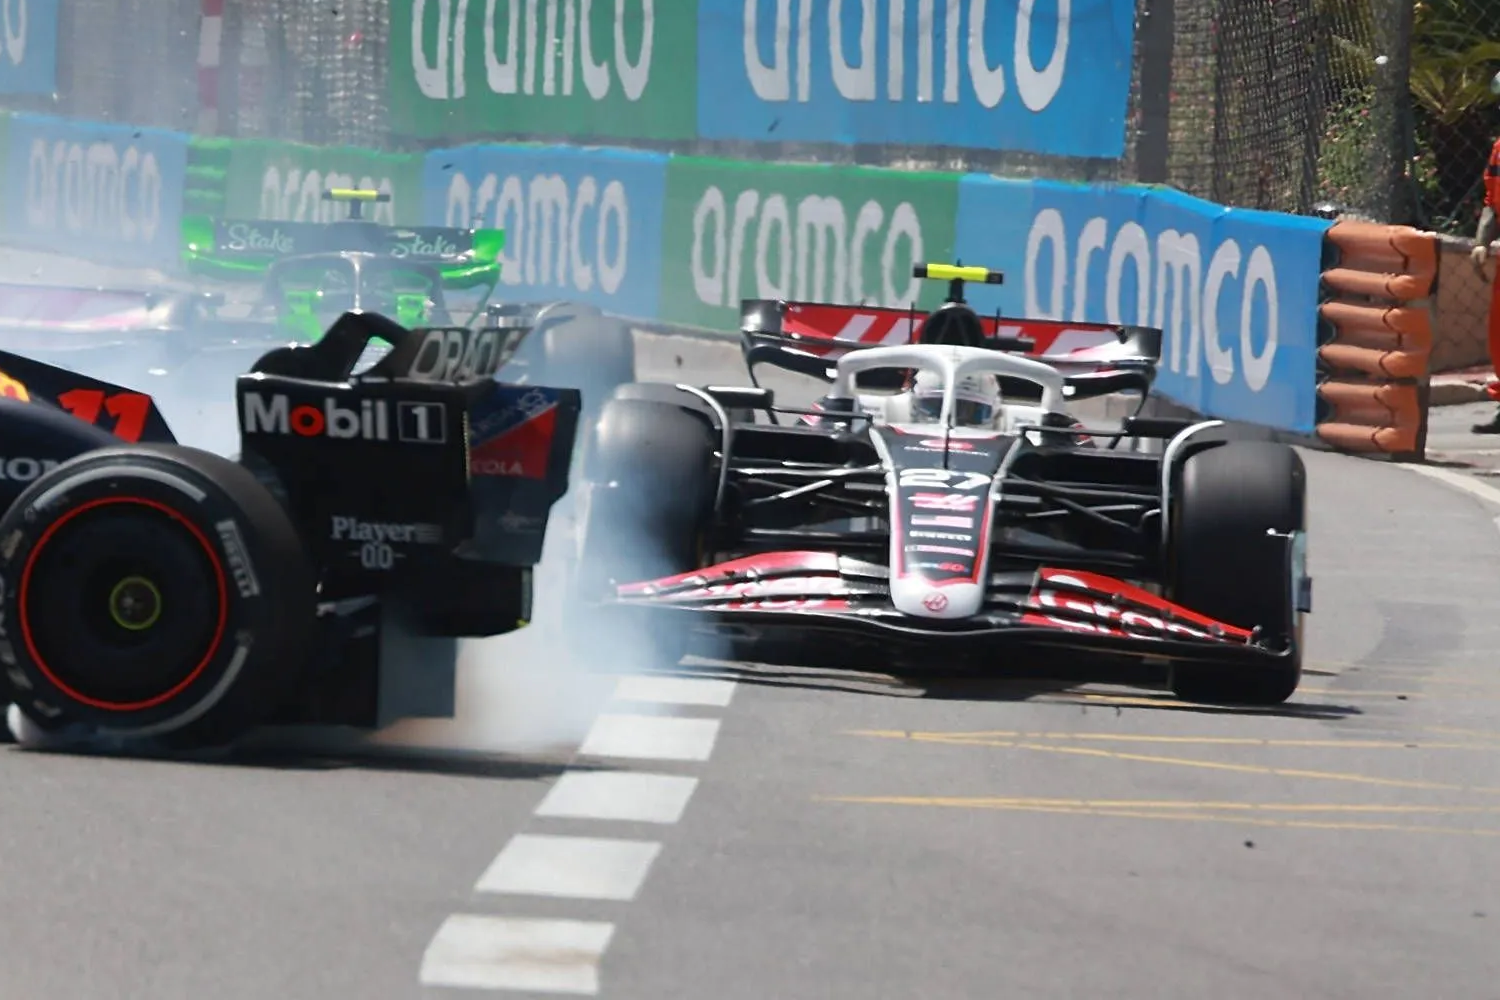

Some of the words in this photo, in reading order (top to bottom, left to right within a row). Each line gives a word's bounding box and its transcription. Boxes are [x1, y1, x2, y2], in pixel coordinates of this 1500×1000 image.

[27, 136, 161, 243] aramco
[228, 223, 294, 252] Stake
[392, 235, 457, 258] Stake
[445, 171, 630, 295] aramco
[692, 185, 924, 310] aramco
[1024, 208, 1278, 393] aramco
[58, 388, 153, 443] 11
[244, 393, 389, 441] Mobil
[900, 468, 993, 490] 27
